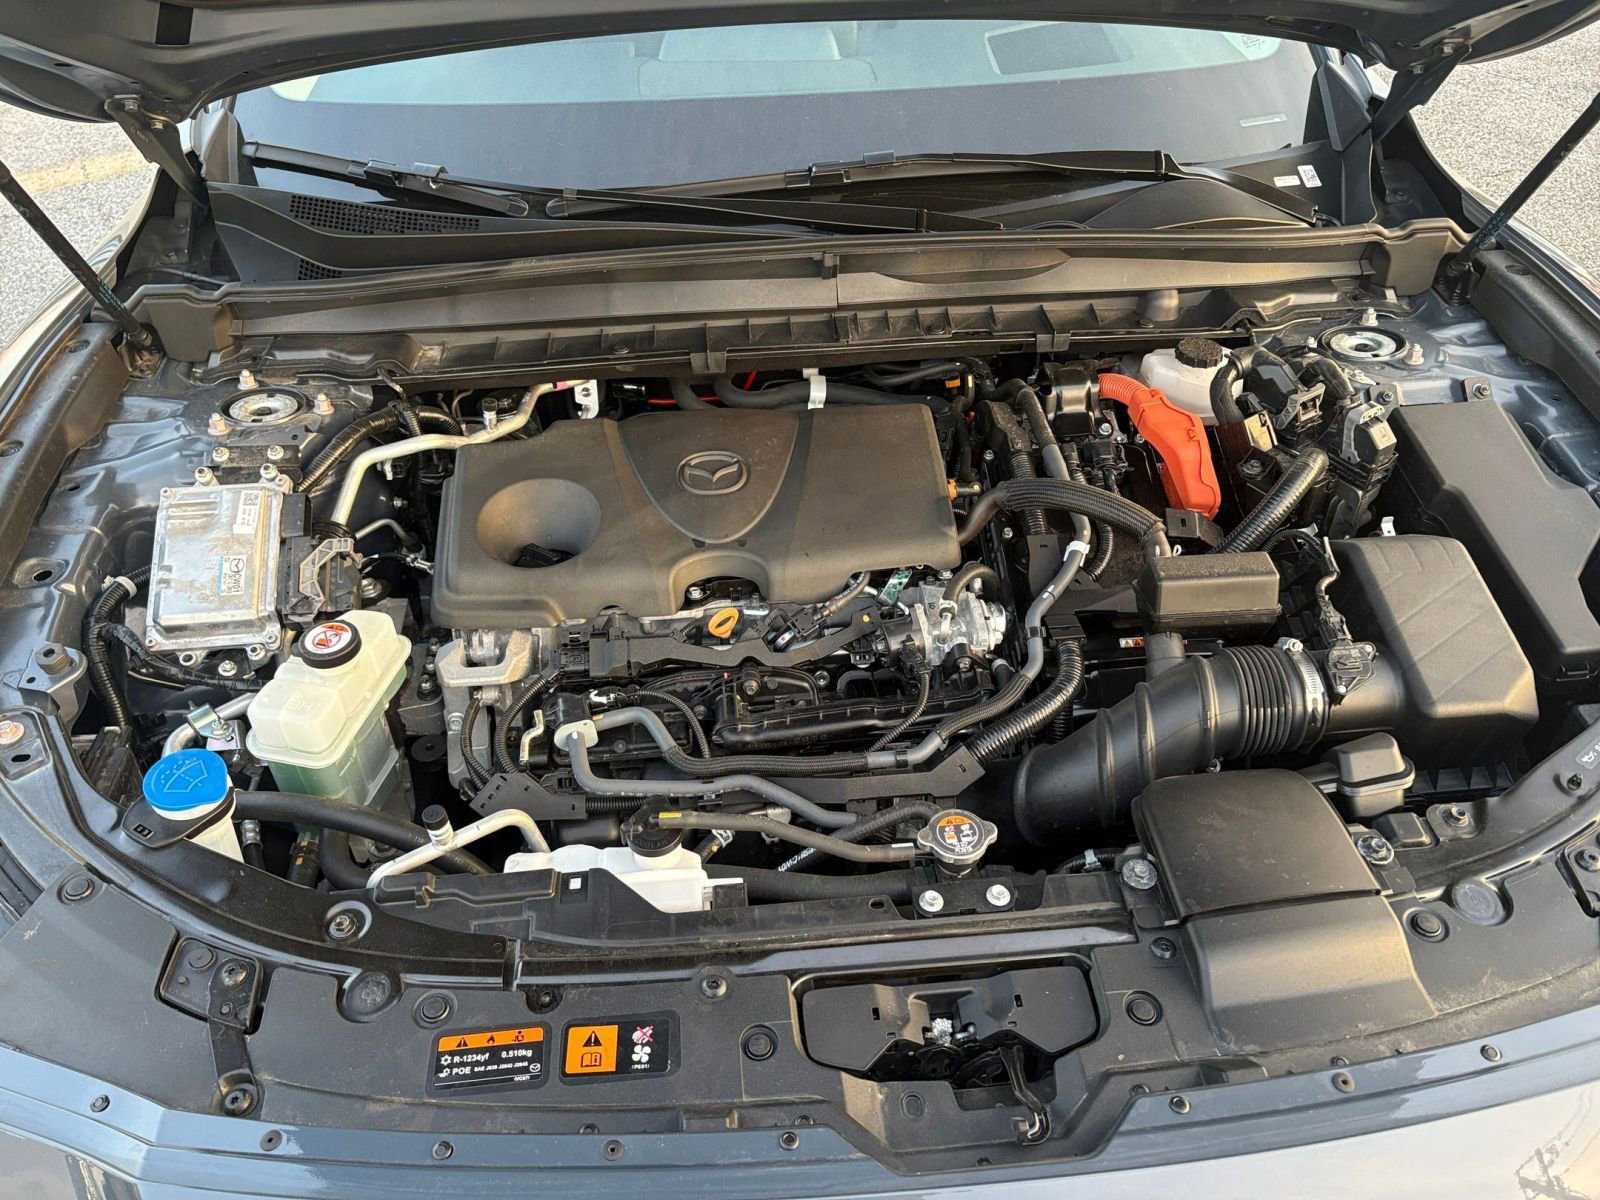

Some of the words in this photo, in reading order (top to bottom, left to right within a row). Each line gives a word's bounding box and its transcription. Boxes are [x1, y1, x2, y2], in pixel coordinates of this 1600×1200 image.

[453, 1052, 490, 1064] R-1234yf
[501, 1049, 533, 1059] 0.510kg
[452, 1066, 472, 1076] POE
